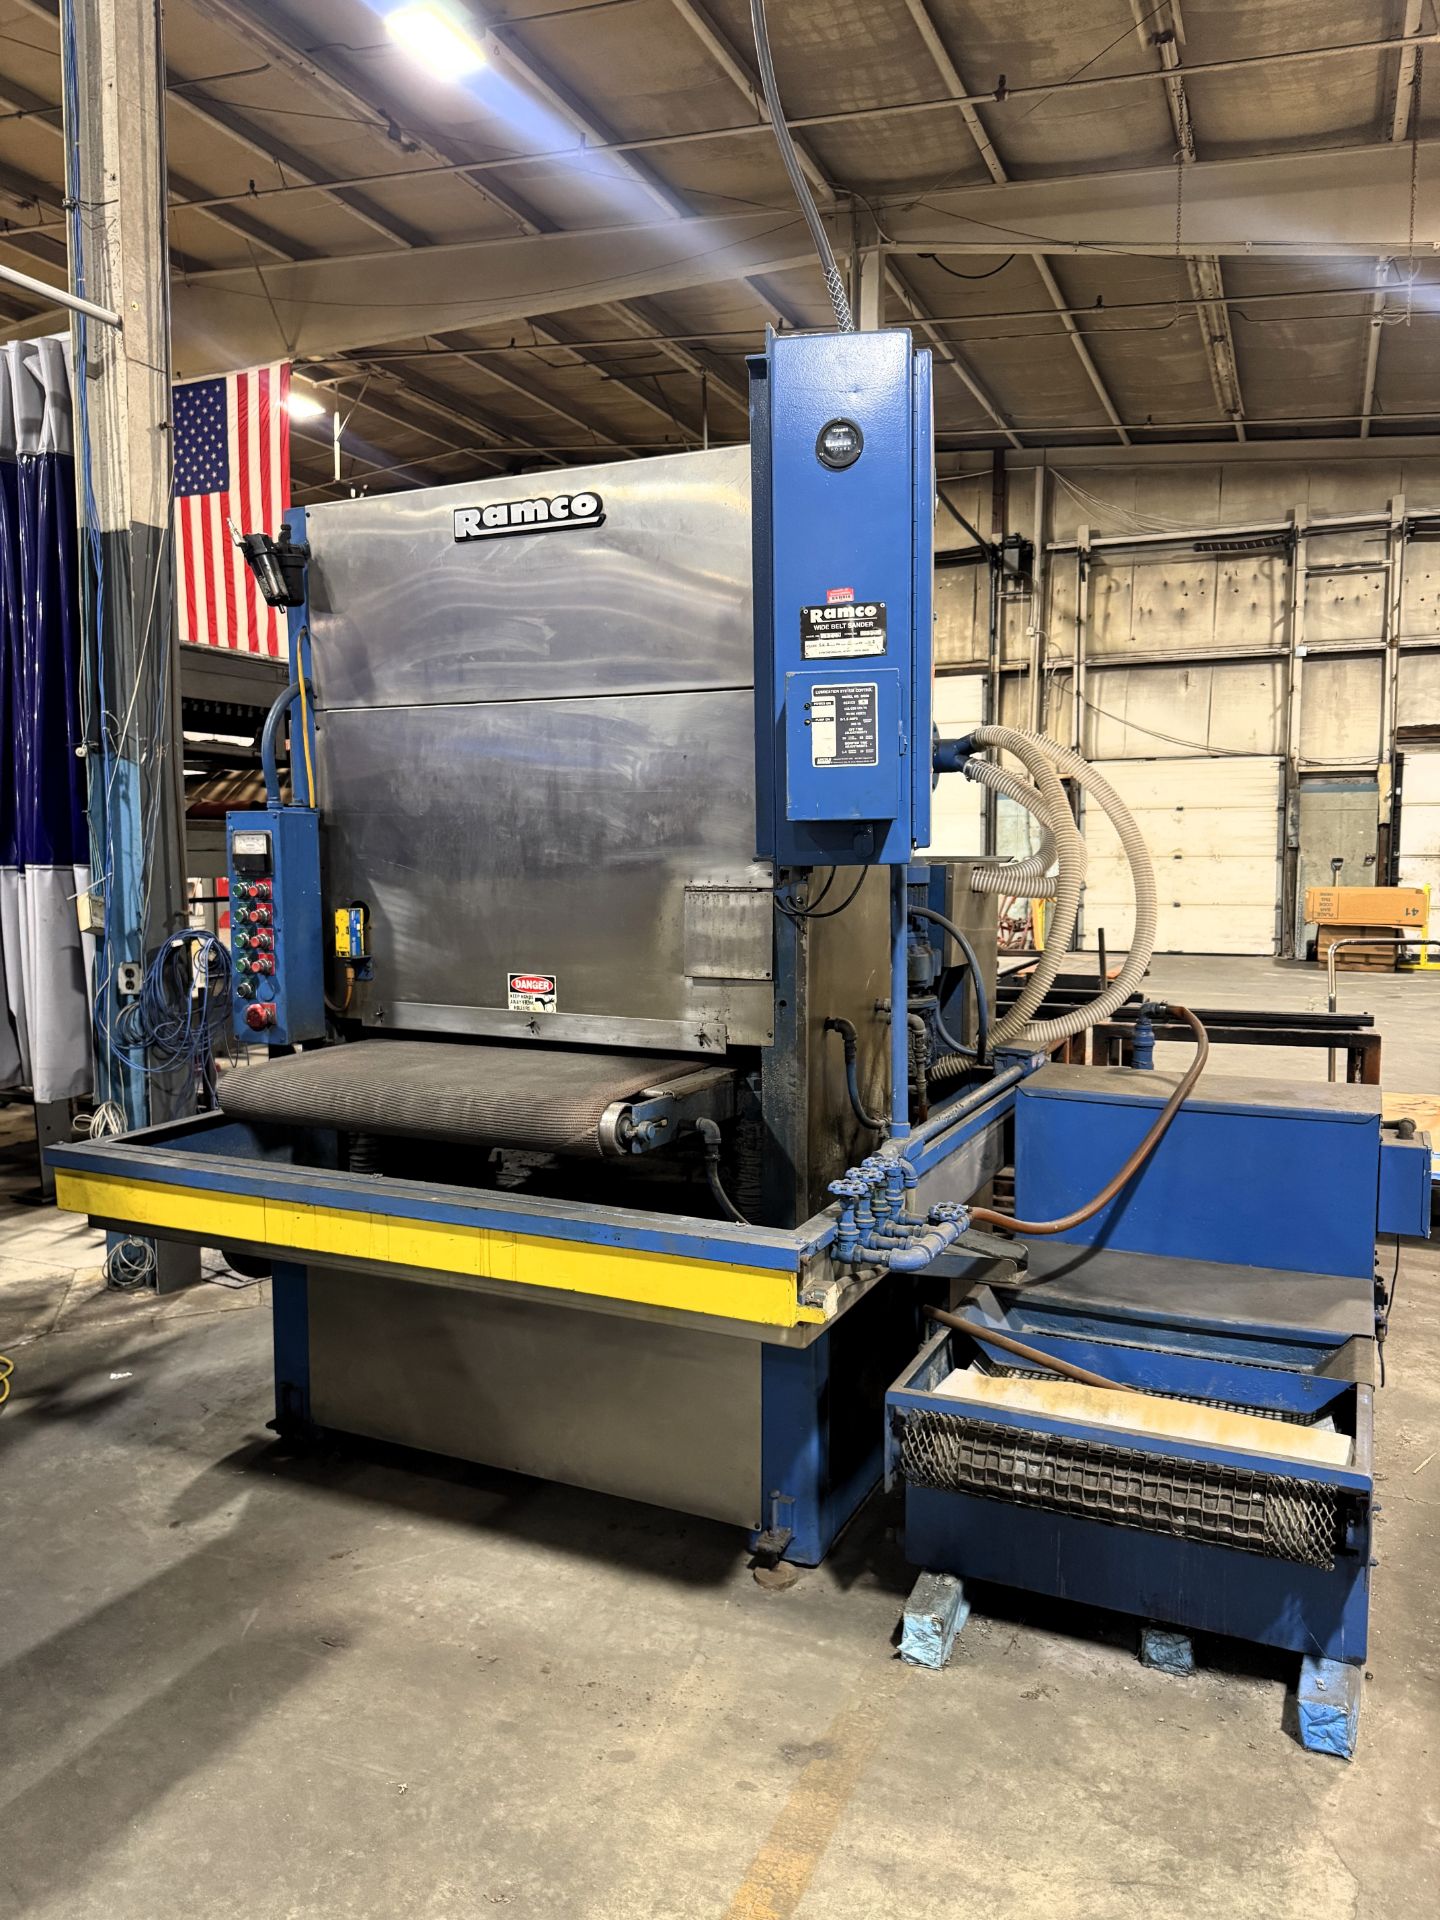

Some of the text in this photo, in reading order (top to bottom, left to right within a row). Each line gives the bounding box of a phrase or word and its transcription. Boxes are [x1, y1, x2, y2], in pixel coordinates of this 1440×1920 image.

[454, 492, 603, 538] Ramco
[810, 605, 877, 624] Ramco
[847, 621, 874, 629] SANDER
[515, 979, 550, 990] DANGER
